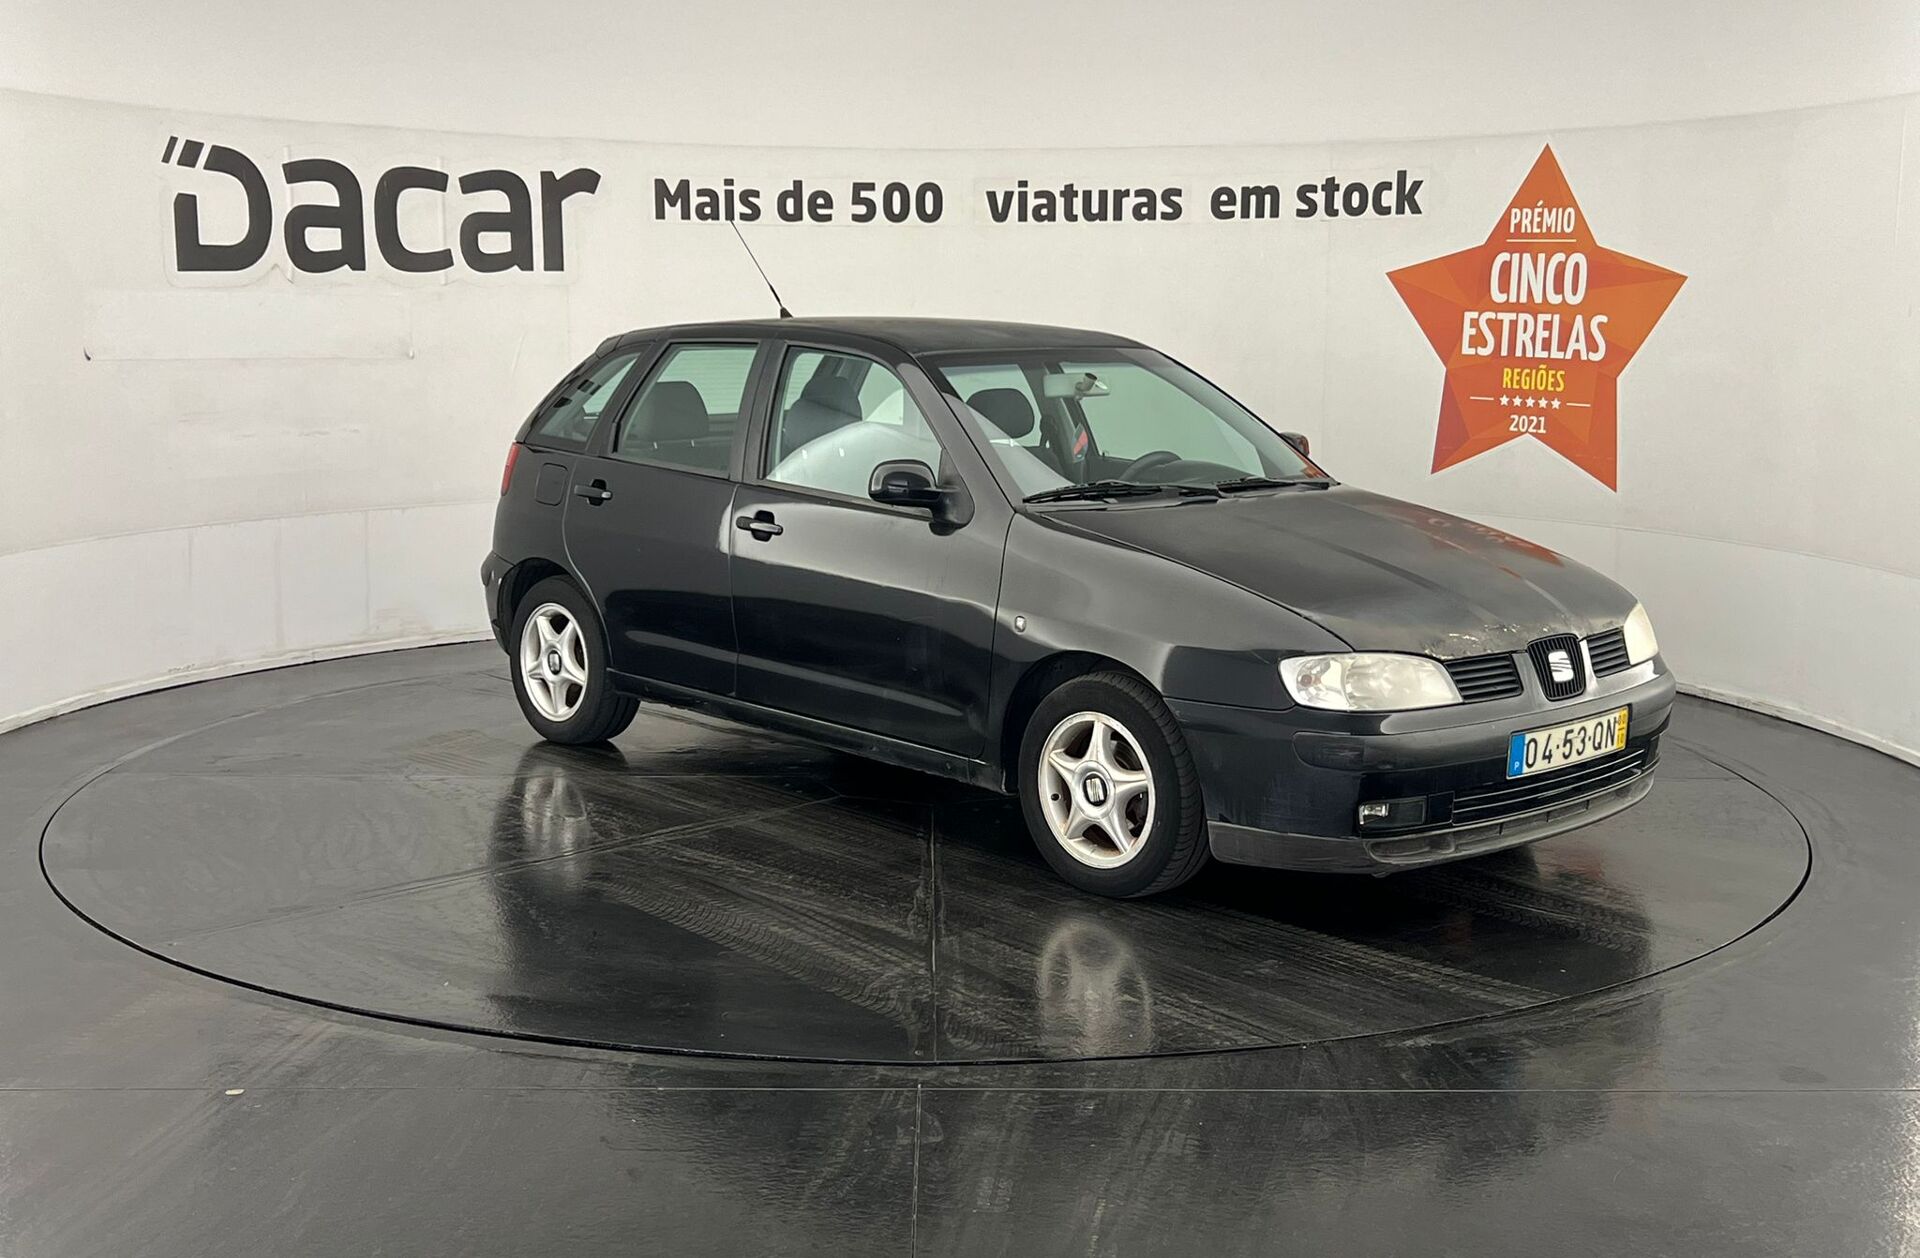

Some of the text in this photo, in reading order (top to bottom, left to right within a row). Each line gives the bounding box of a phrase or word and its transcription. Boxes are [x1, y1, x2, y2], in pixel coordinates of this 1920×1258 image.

[162, 136, 601, 273] Dacar
[654, 169, 1424, 224] Mais de 500 viaturas em stock
[1509, 200, 1576, 234] PRÉMIO
[1489, 252, 1589, 306] CINCO
[1460, 311, 1609, 362] ESTRELAS
[1502, 364, 1566, 393] REGIÕES
[1509, 414, 1547, 434] 2021
